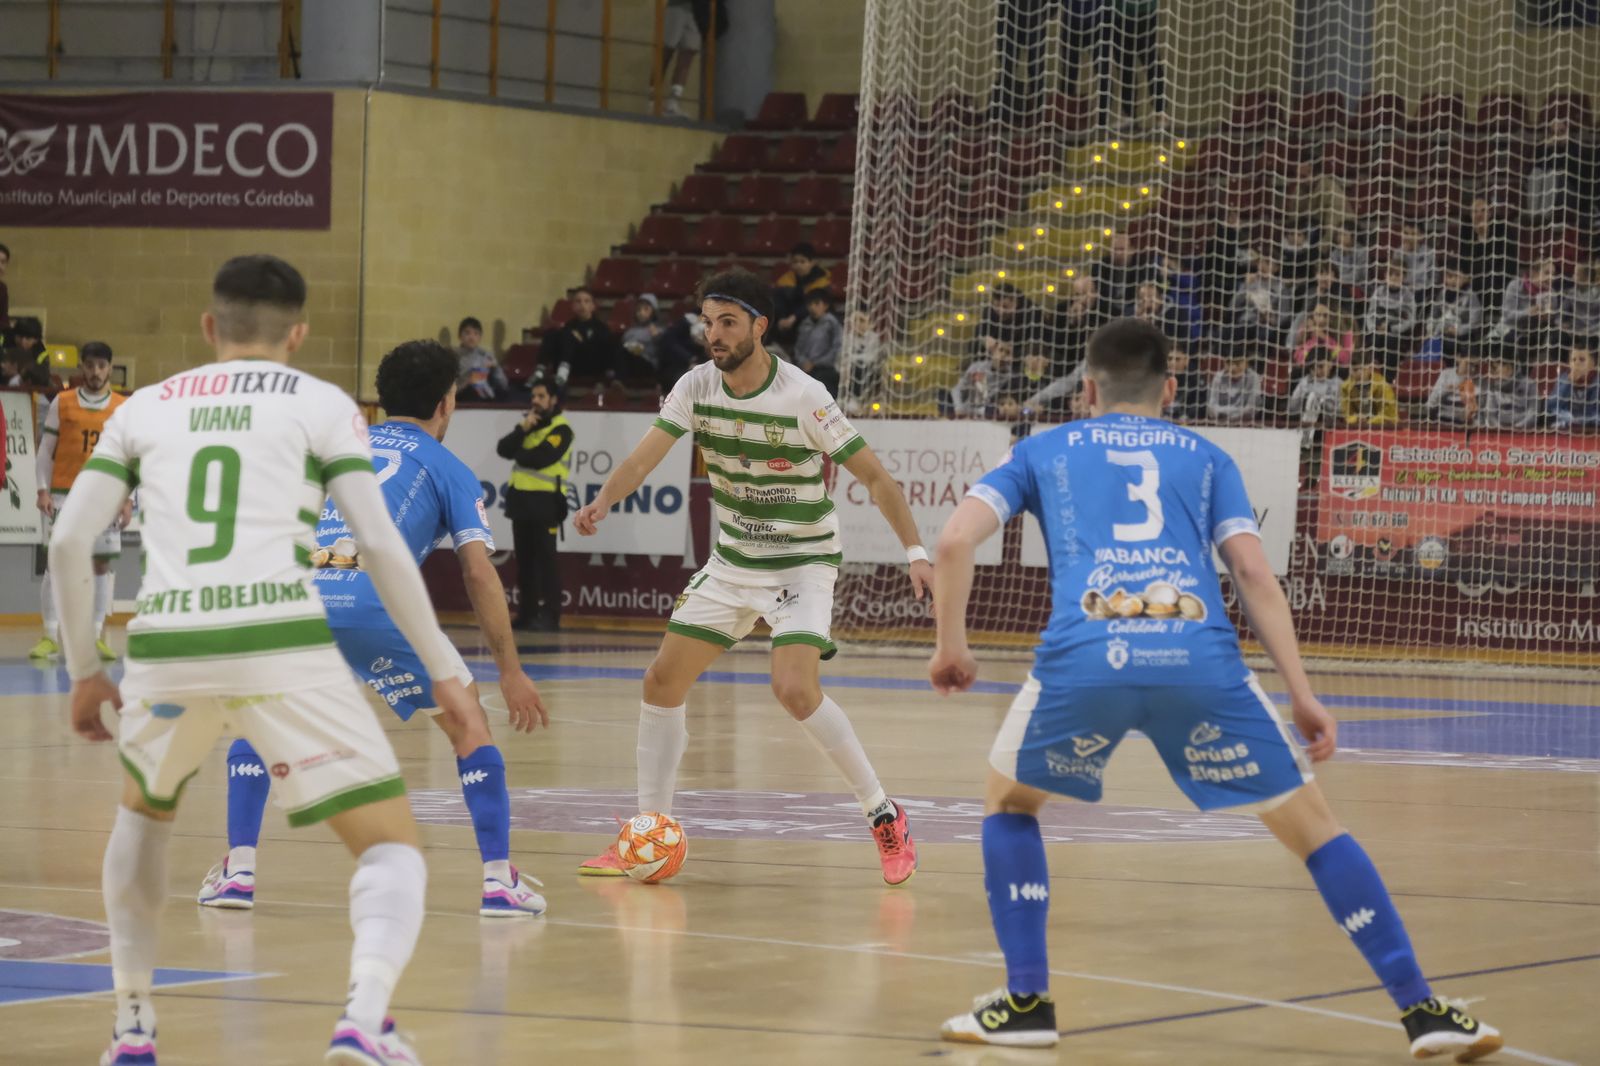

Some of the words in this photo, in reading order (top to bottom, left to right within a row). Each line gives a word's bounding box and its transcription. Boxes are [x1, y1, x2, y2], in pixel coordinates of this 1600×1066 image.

[65, 122, 318, 178] IMDECO
[58, 189, 137, 209] Municipal
[141, 188, 161, 206] de
[166, 189, 240, 208] Deportes
[244, 189, 314, 207] Córdoba
[189, 404, 252, 432] VIANA
[1068, 431, 1085, 447] P.
[1092, 428, 1197, 451] RAGGIATI
[1389, 443, 1473, 464] Estación
[1479, 449, 1501, 465] de
[1508, 449, 1600, 467] Servicios
[186, 445, 241, 566] 9
[1106, 449, 1165, 542] 3
[1099, 547, 1190, 566] ABANCA
[1456, 615, 1560, 640] Instituto
[1184, 743, 1249, 763] Grúas
